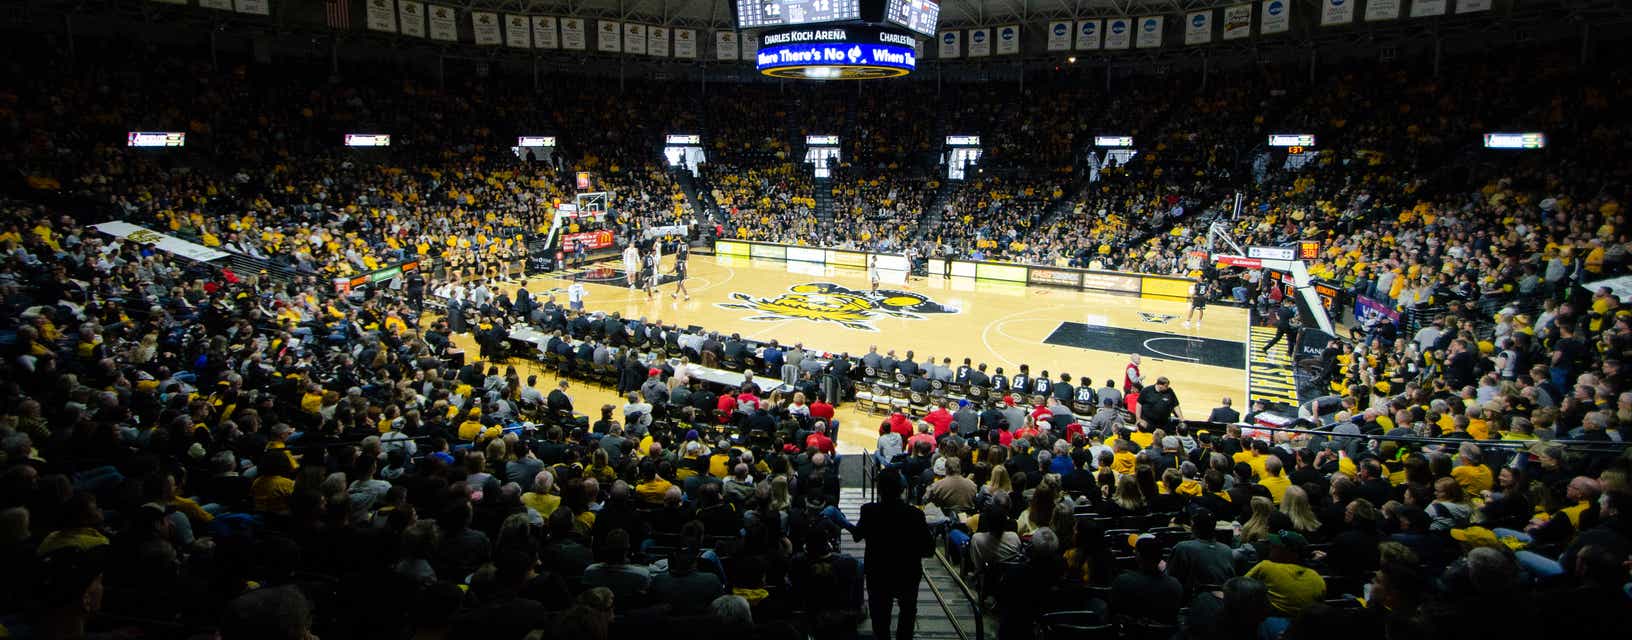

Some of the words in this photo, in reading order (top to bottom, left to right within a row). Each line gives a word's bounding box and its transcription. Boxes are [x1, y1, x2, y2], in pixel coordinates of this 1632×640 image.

[764, 4, 781, 16] 12
[812, 0, 830, 12] 12
[764, 32, 790, 45] CHARLES
[791, 31, 814, 41] KOCH
[814, 30, 847, 41] ARENA
[879, 32, 906, 44] CHARLES
[779, 48, 822, 62] There's
[824, 47, 845, 61] No
[872, 48, 904, 64] Where
[1013, 378, 1024, 389] 22
[1036, 382, 1047, 393] 10
[1250, 366, 1299, 408] STATE
[1077, 391, 1090, 401] 20
